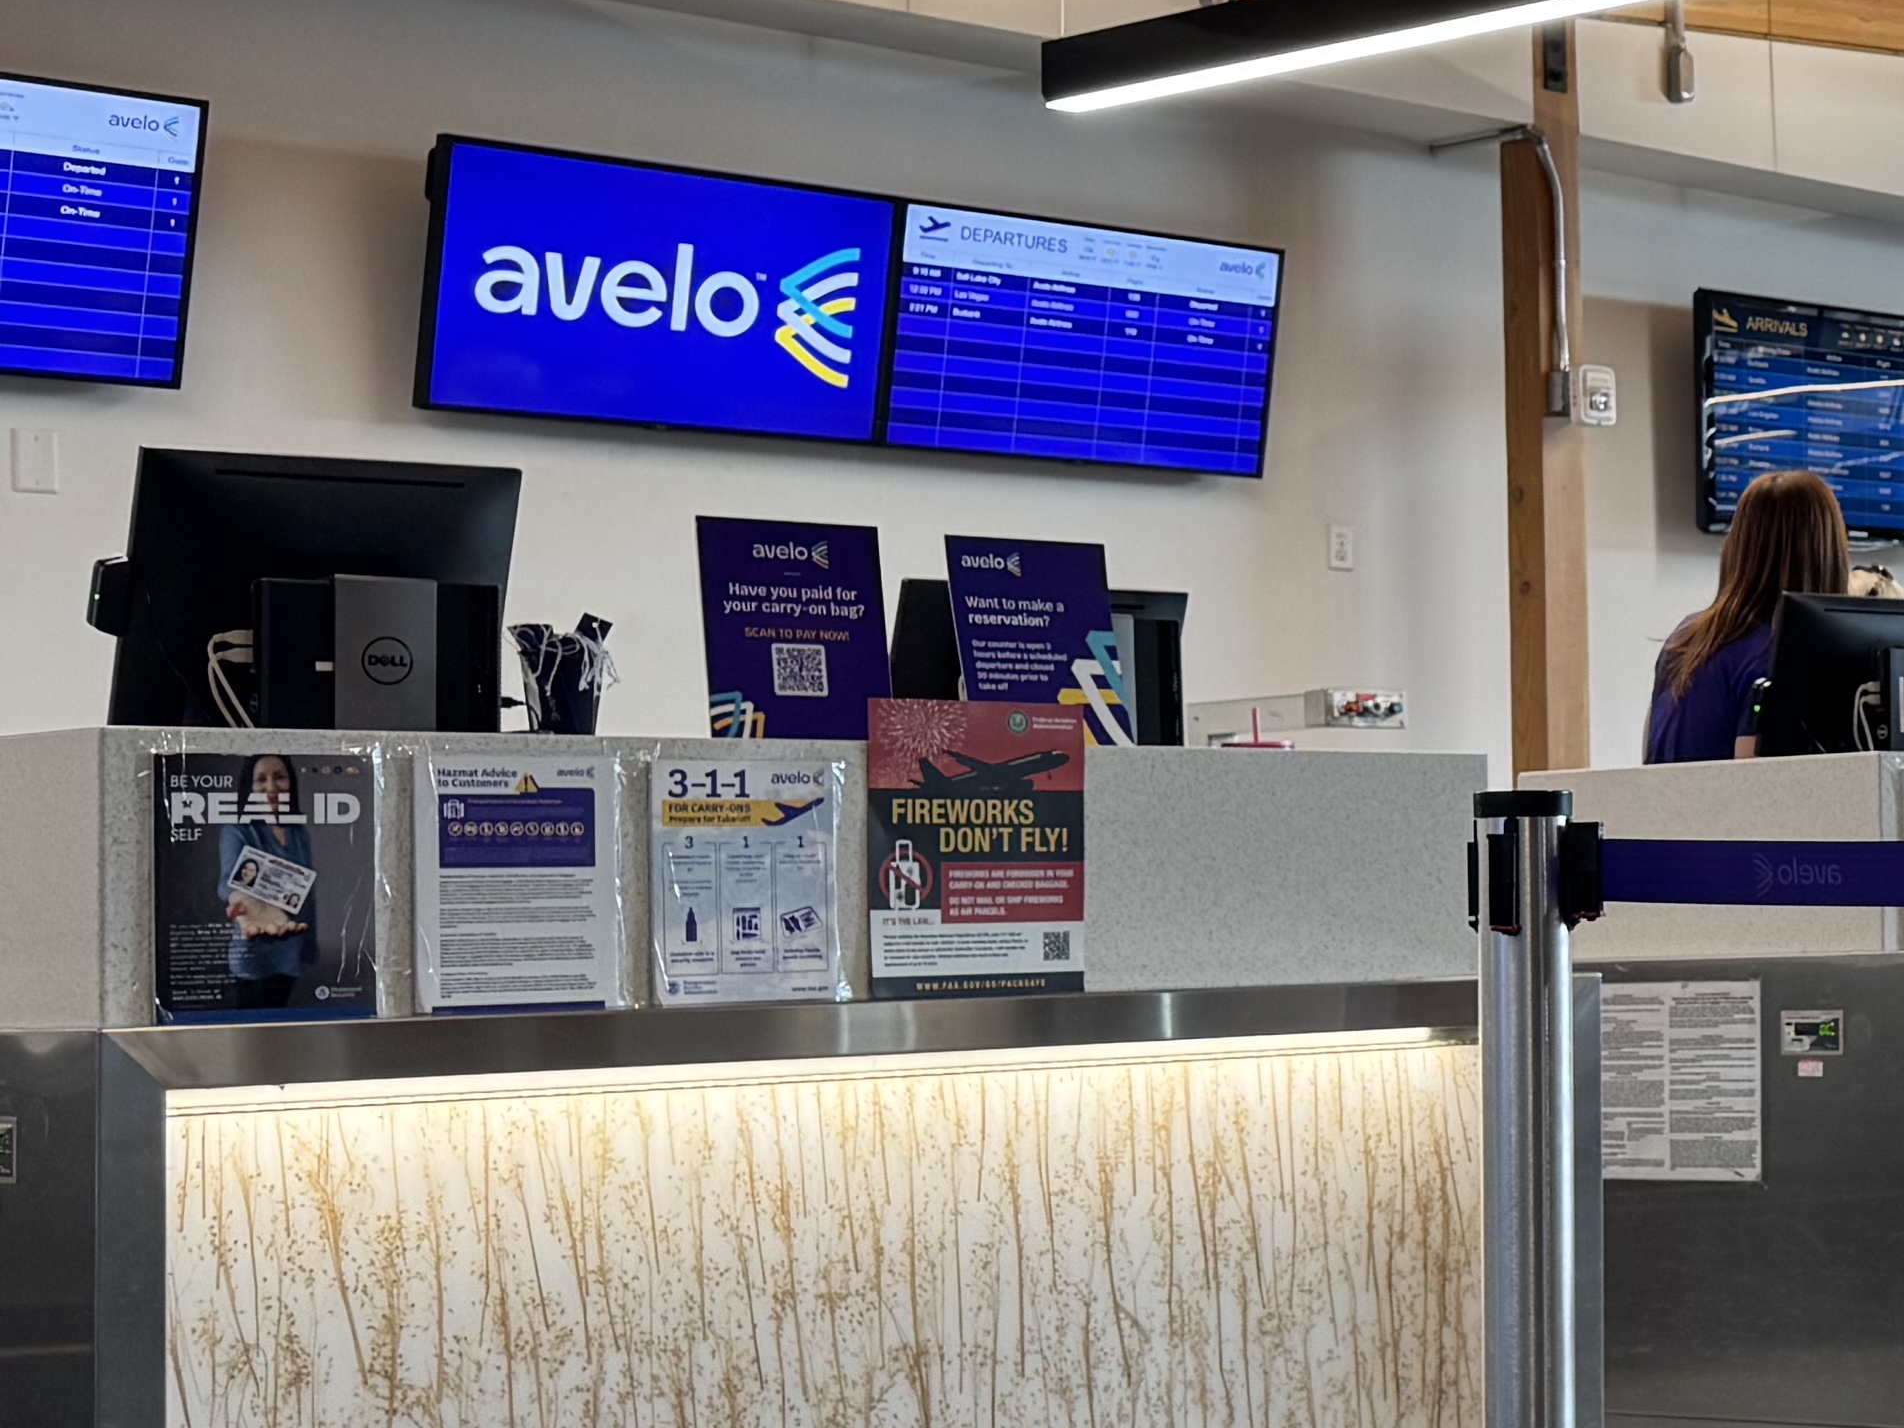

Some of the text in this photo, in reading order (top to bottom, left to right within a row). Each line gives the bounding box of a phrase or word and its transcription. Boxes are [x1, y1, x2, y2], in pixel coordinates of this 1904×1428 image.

[109, 114, 160, 132] avelo
[961, 225, 1068, 253] DEPARTURES
[1220, 262, 1253, 275] avelo
[474, 242, 759, 337] avelo
[1746, 316, 1808, 337] ARRIVALS
[752, 542, 808, 560] avelo
[962, 554, 1005, 569] avelo
[729, 582, 857, 601] Have you paid for
[723, 600, 865, 620] your carry-on bag?
[965, 596, 1064, 612] Want to make a
[968, 613, 1050, 627] reservation?
[745, 627, 776, 638] SCAN
[780, 629, 793, 639] TO
[796, 630, 817, 639] PAY
[368, 654, 407, 667] DELL
[438, 768, 517, 777] Hazmat Advice
[771, 771, 810, 785] avelo
[171, 775, 233, 787] BE YOUR
[438, 778, 509, 788] to Customers
[668, 769, 749, 798] 3-1-1
[171, 792, 361, 824] REAL ID
[669, 804, 688, 813] FOR
[892, 799, 1034, 824] FIREWORKS
[171, 828, 202, 841] SELF
[940, 828, 1069, 852] DON'T FLY!
[685, 836, 693, 849] 3
[743, 836, 749, 848] 1
[797, 836, 804, 848] 1
